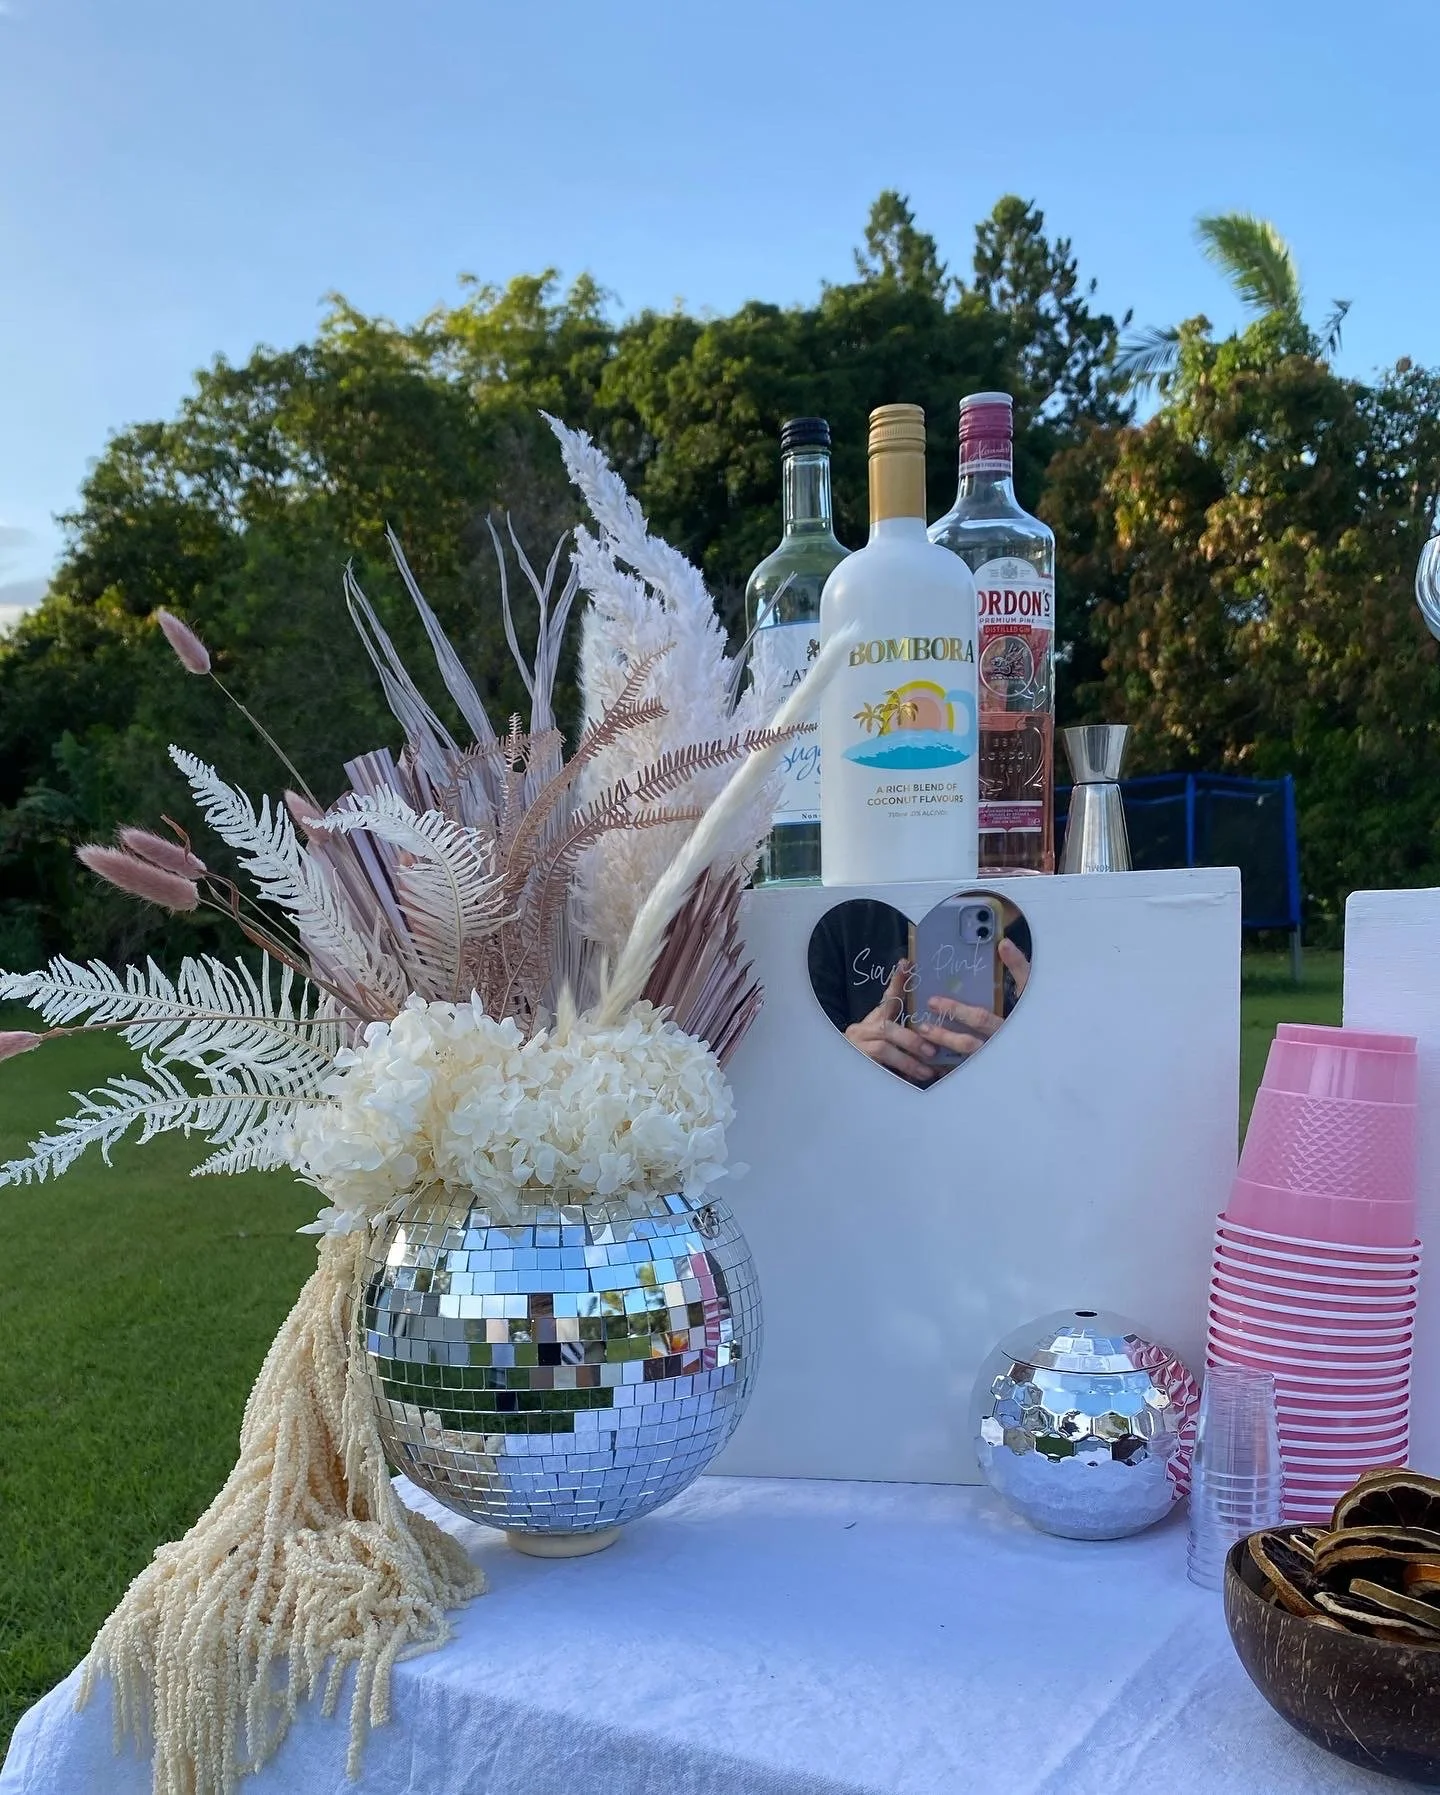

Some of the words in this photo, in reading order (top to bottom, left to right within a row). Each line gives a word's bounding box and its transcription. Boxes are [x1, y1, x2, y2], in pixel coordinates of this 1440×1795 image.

[978, 589, 1052, 617] ORDON'S
[848, 636, 975, 667] BOMBORA
[867, 796, 918, 806] COCONUT
[920, 794, 964, 803] FLAVOURS
[876, 785, 884, 794] A
[886, 784, 910, 793] RICH
[913, 783, 944, 792] BLEND
[946, 783, 957, 791] OF
[931, 936, 987, 977] Pink
